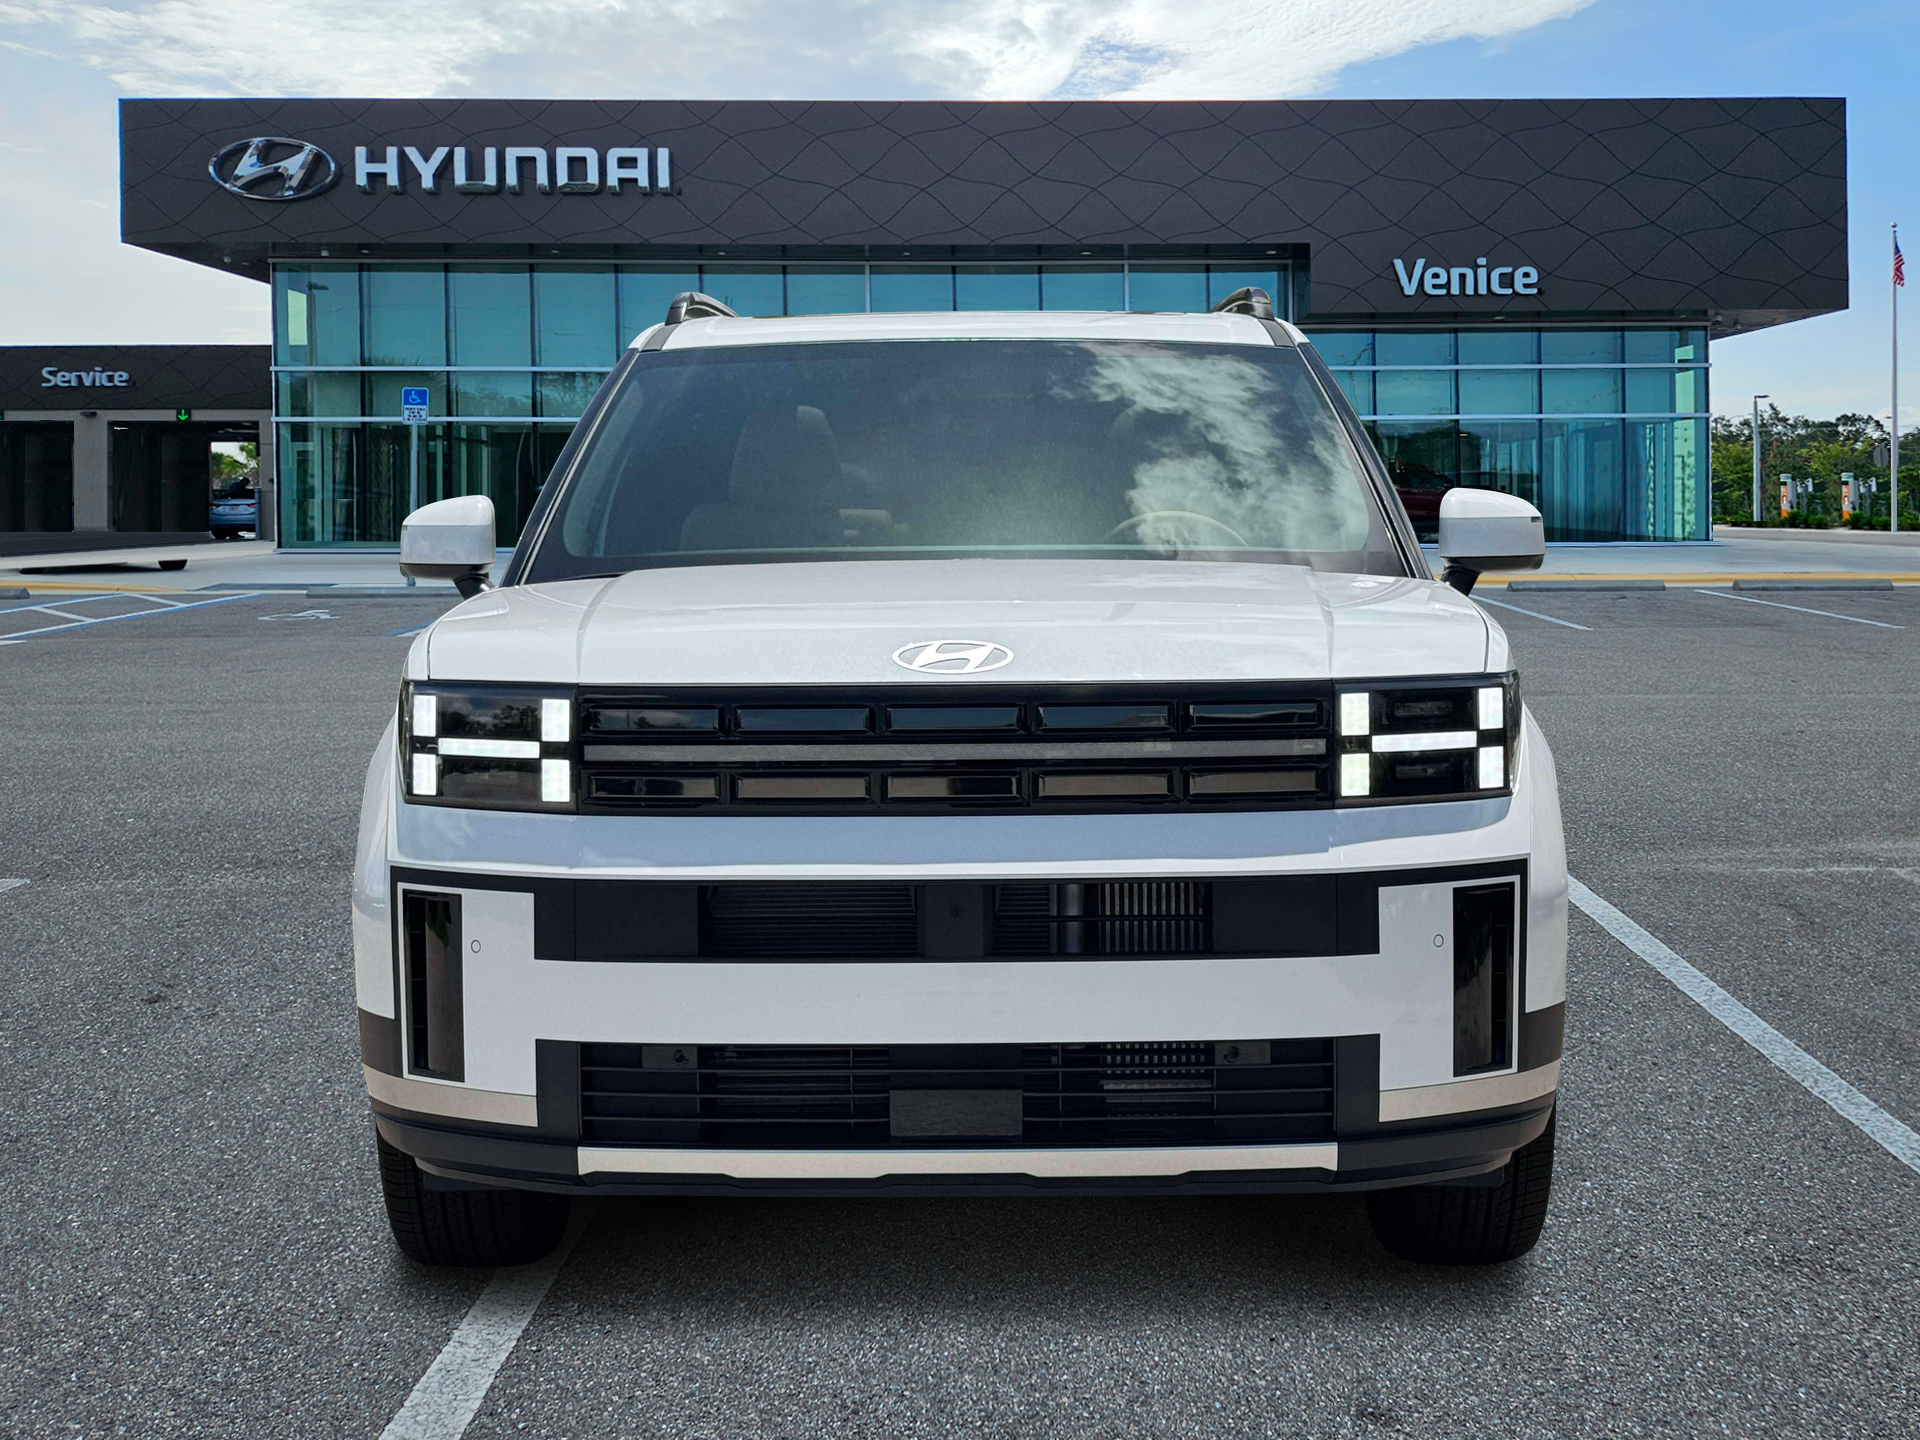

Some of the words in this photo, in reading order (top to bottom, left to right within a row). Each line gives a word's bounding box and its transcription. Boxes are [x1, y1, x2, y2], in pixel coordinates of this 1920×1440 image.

[354, 146, 671, 194] HYUNDAI
[1393, 257, 1539, 295] Venice
[41, 366, 130, 387] Service
